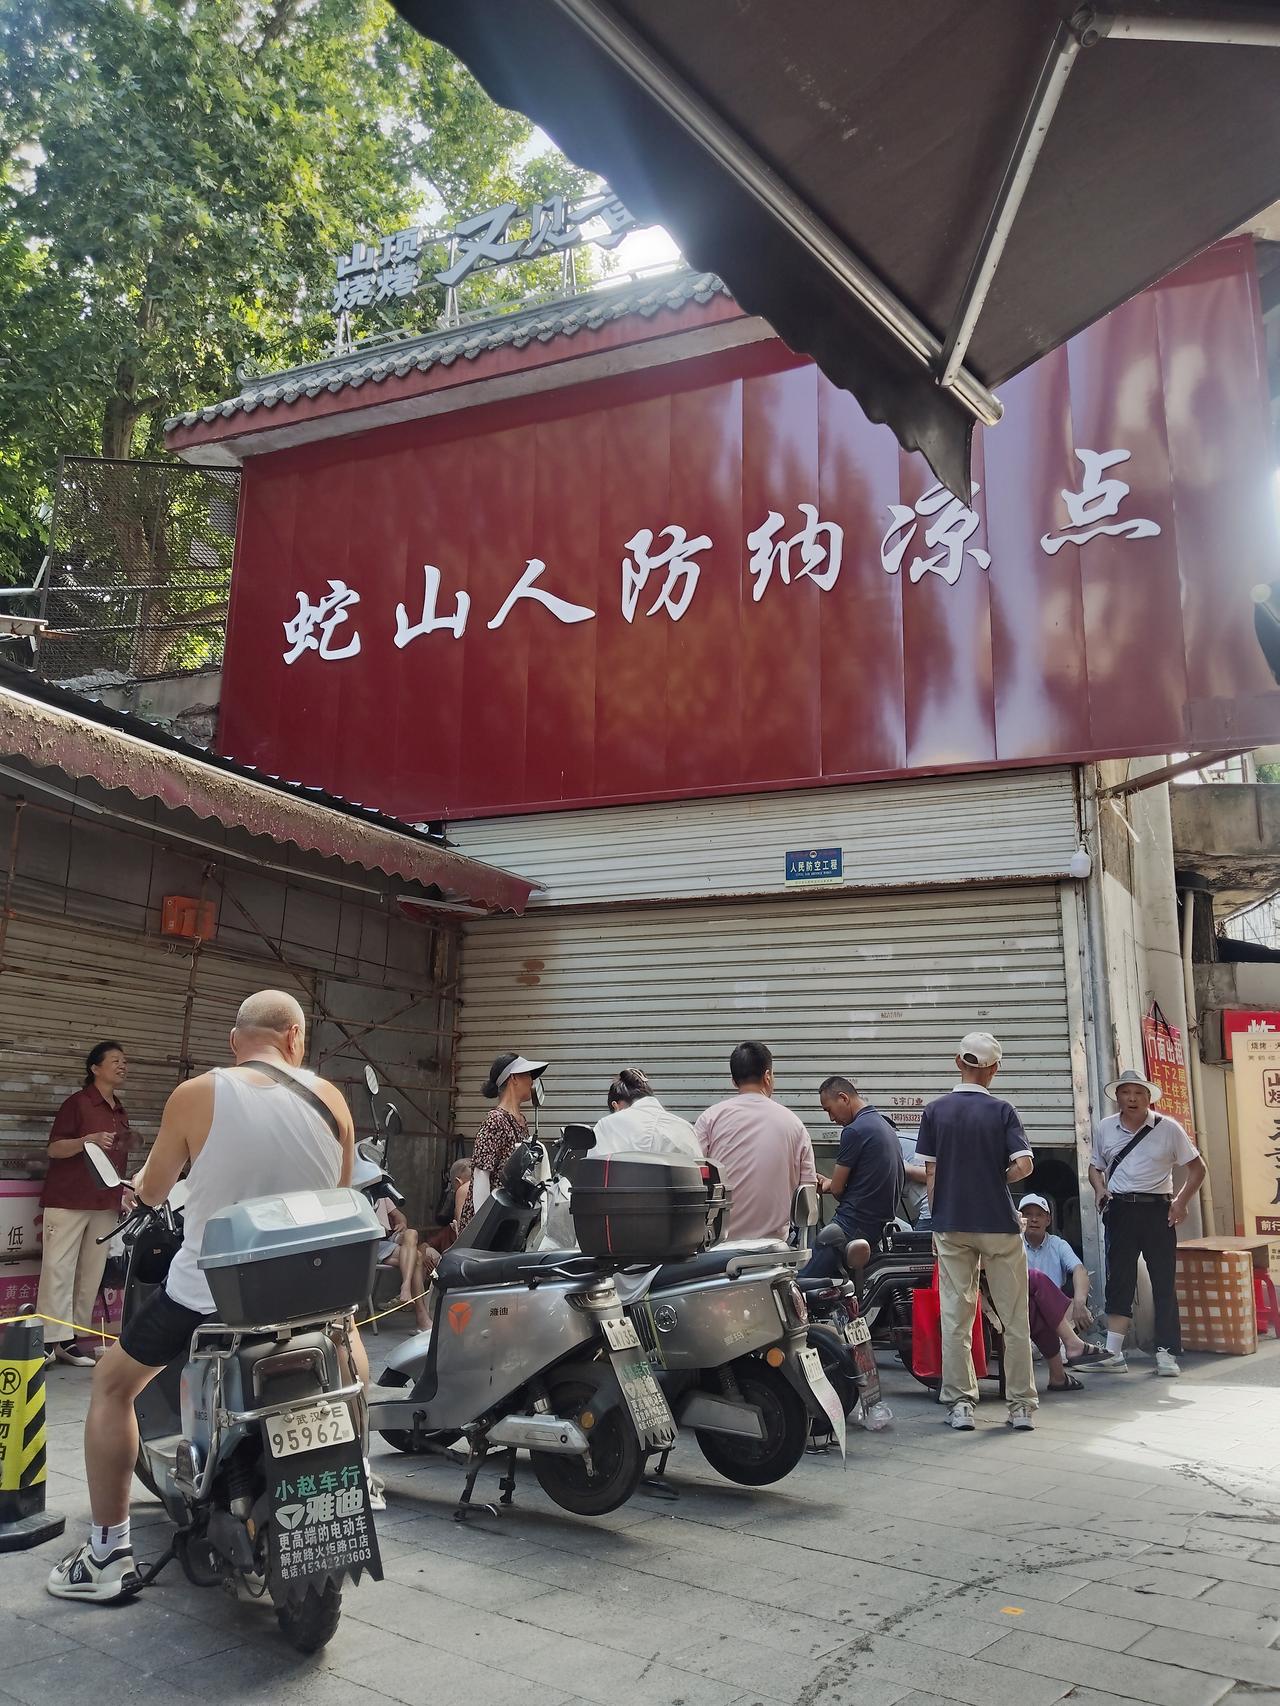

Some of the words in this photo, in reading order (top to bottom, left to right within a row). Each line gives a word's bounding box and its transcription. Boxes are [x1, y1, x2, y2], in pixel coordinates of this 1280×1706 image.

[337, 226, 421, 279] 山顶
[331, 261, 418, 313] 烧烤
[282, 448, 1162, 665] 蛇山人防纳凉点
[790, 859, 838, 873] 人民防空工程
[1147, 1034, 1185, 1066] 门面出租
[1153, 1061, 1186, 1083] 上下2层
[4, 1283, 38, 1300] 黄金
[272, 1421, 343, 1454] 95962
[274, 1465, 361, 1501] 小赵车行
[305, 1486, 365, 1525] 雅迪
[278, 1515, 368, 1553] 更高端的电动车
[280, 1533, 369, 1568] 解放路火炬路口店
